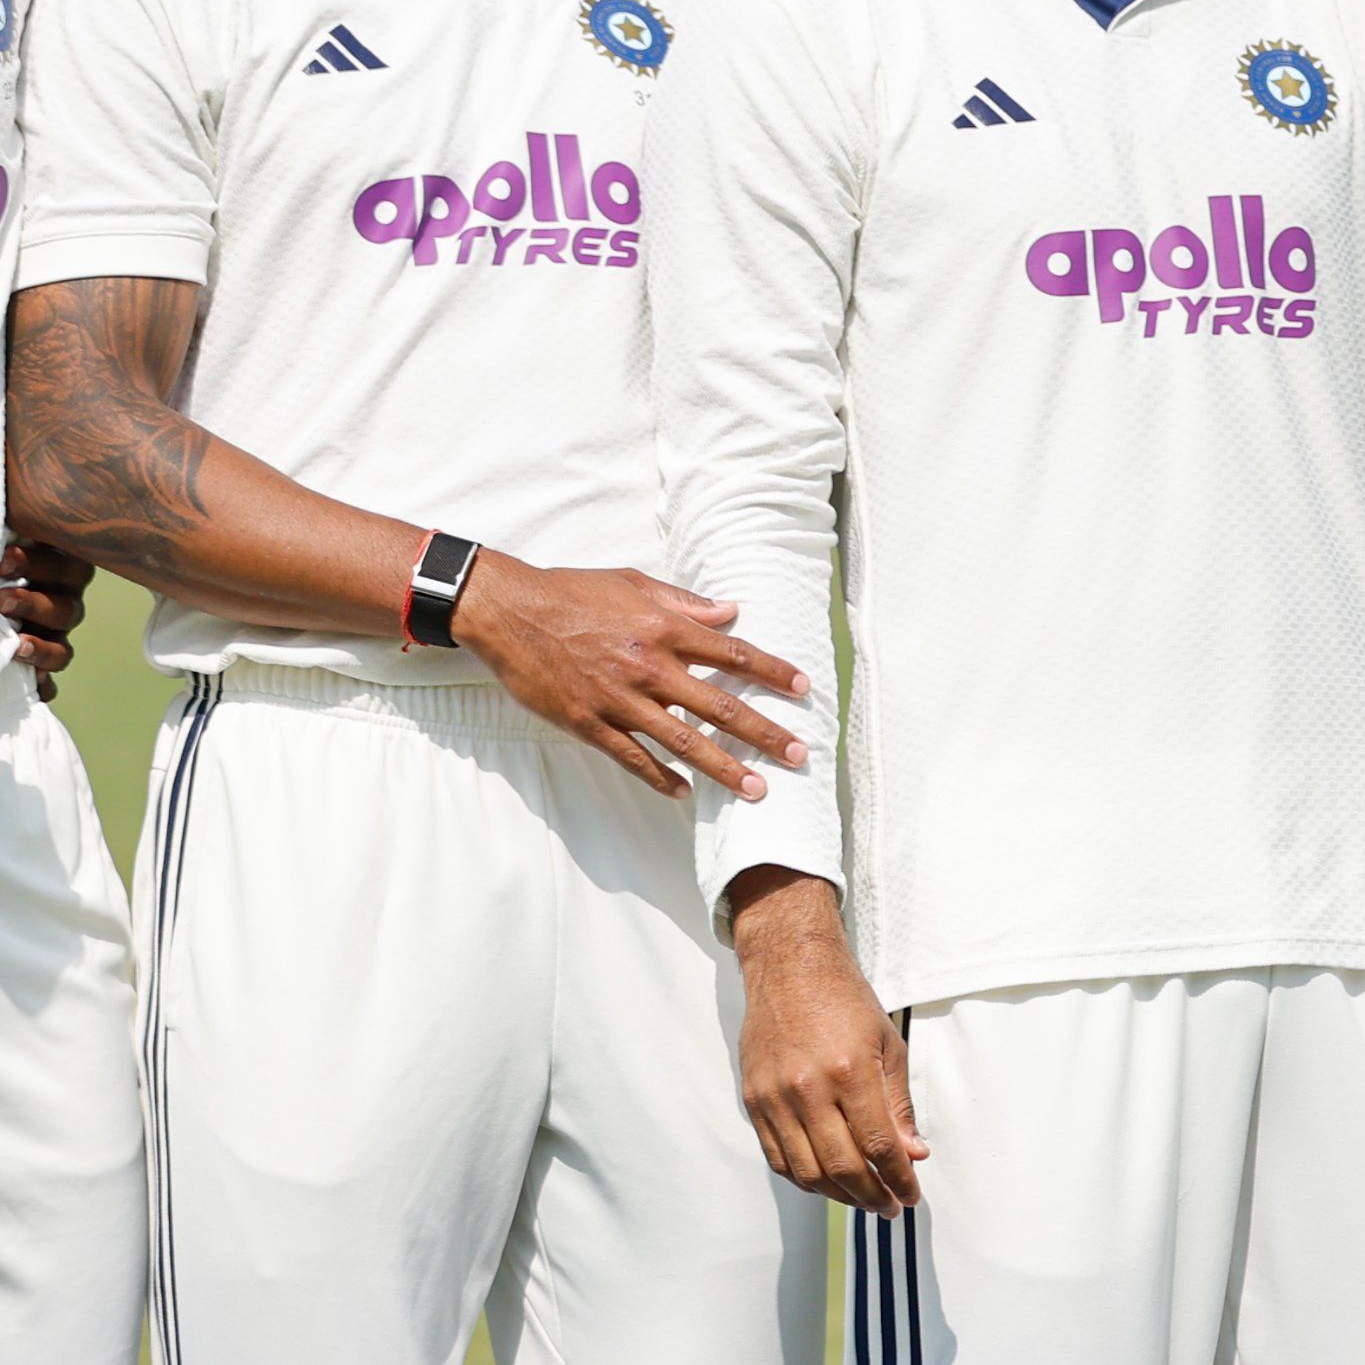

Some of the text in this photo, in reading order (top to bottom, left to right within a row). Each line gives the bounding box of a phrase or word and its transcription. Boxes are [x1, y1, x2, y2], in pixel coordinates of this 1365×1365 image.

[353, 131, 641, 266] apollo
[456, 225, 640, 268] TYRES
[1025, 195, 1316, 324] apollo
[1138, 295, 1316, 338] TYRES
